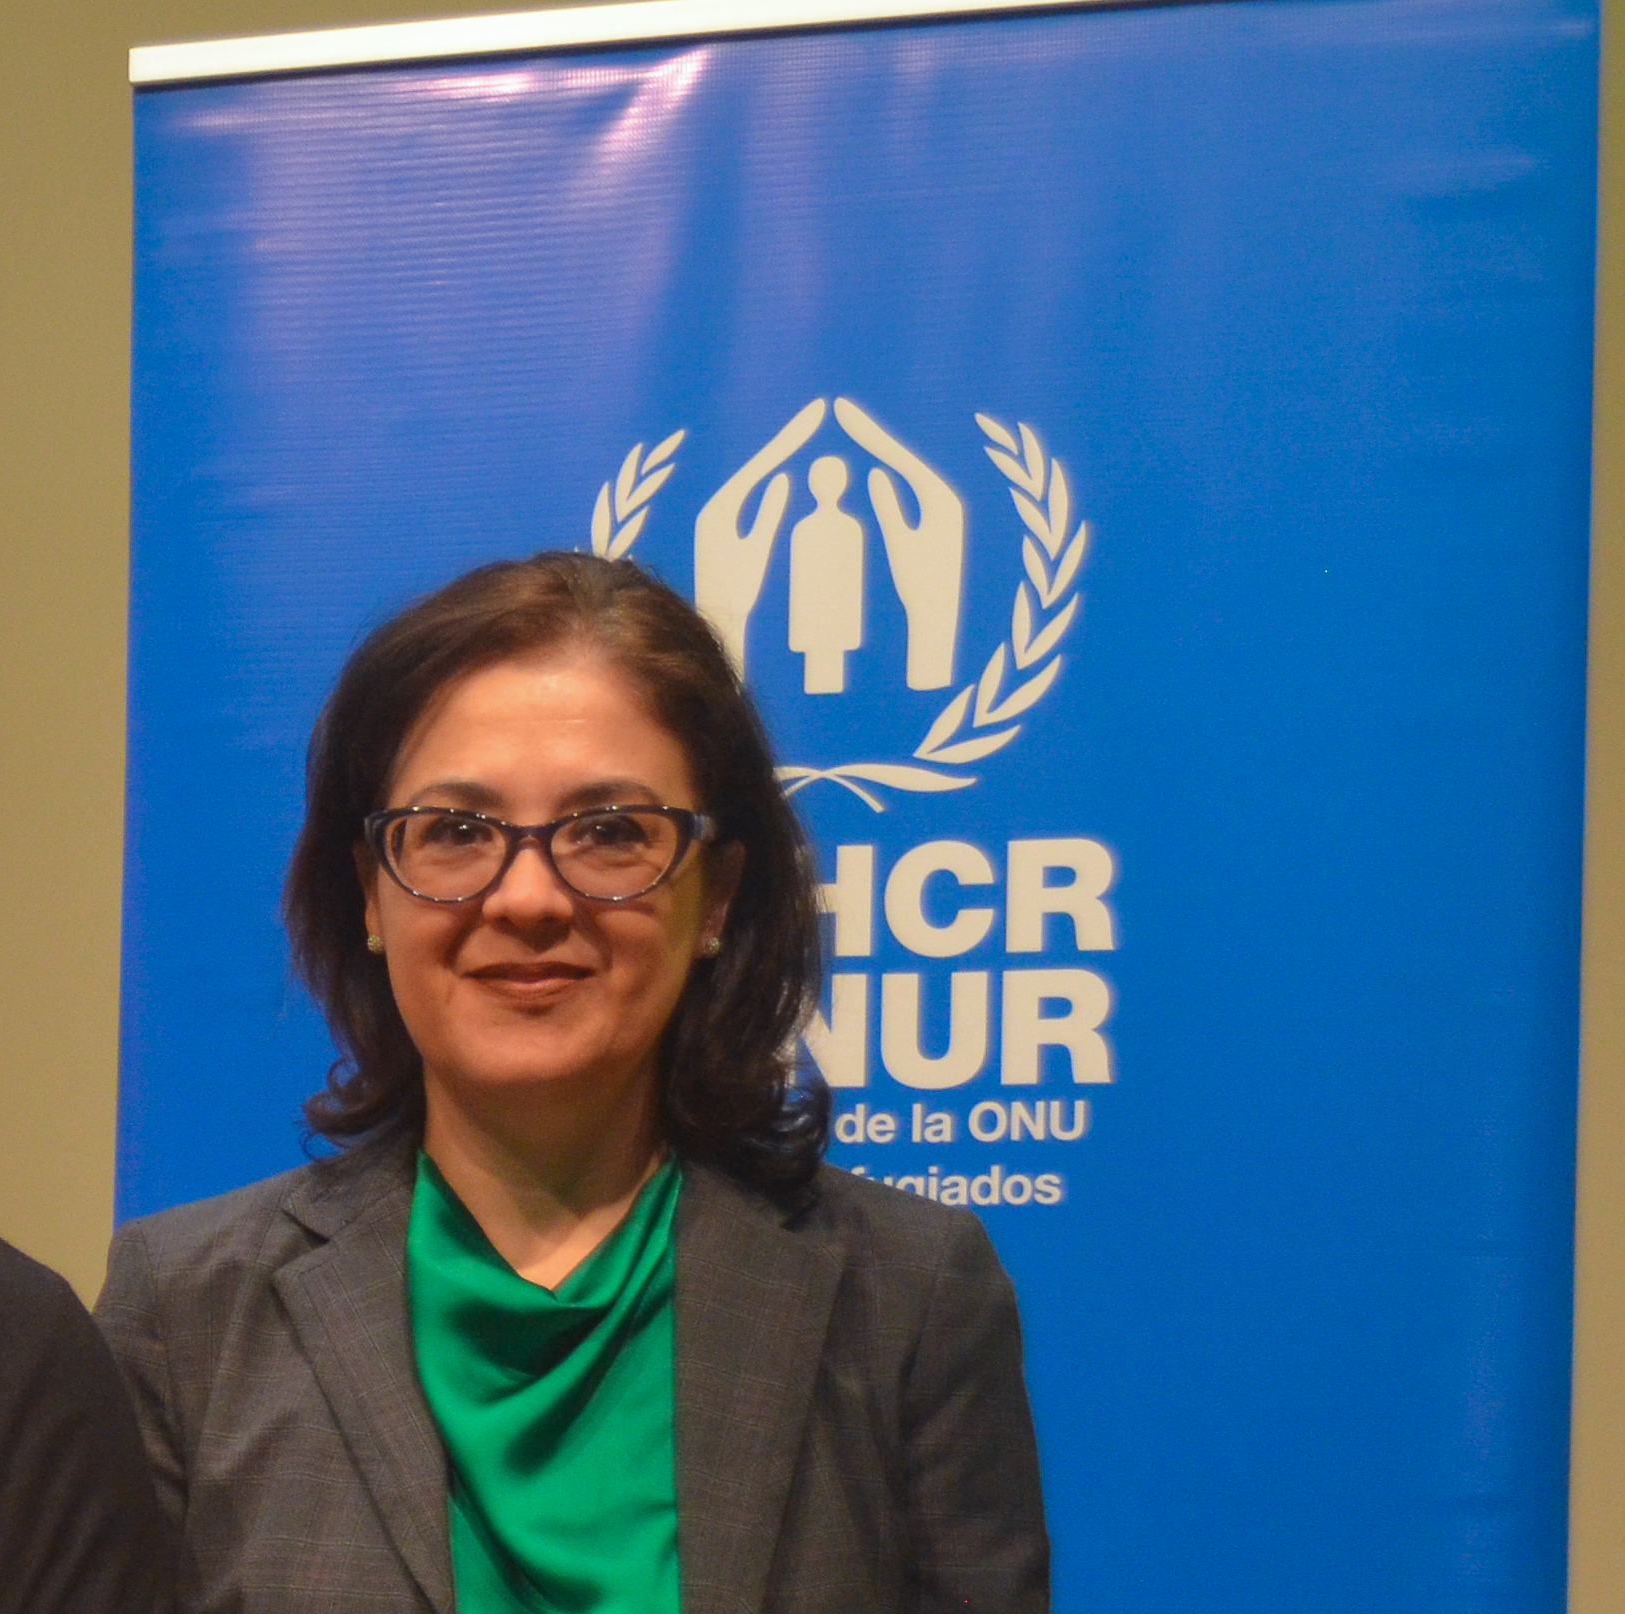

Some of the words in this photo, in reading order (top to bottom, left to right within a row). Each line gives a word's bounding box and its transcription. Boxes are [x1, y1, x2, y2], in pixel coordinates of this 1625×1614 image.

[835, 1103, 896, 1143] de
[912, 1103, 952, 1143] la
[968, 1100, 1085, 1142] ONU
